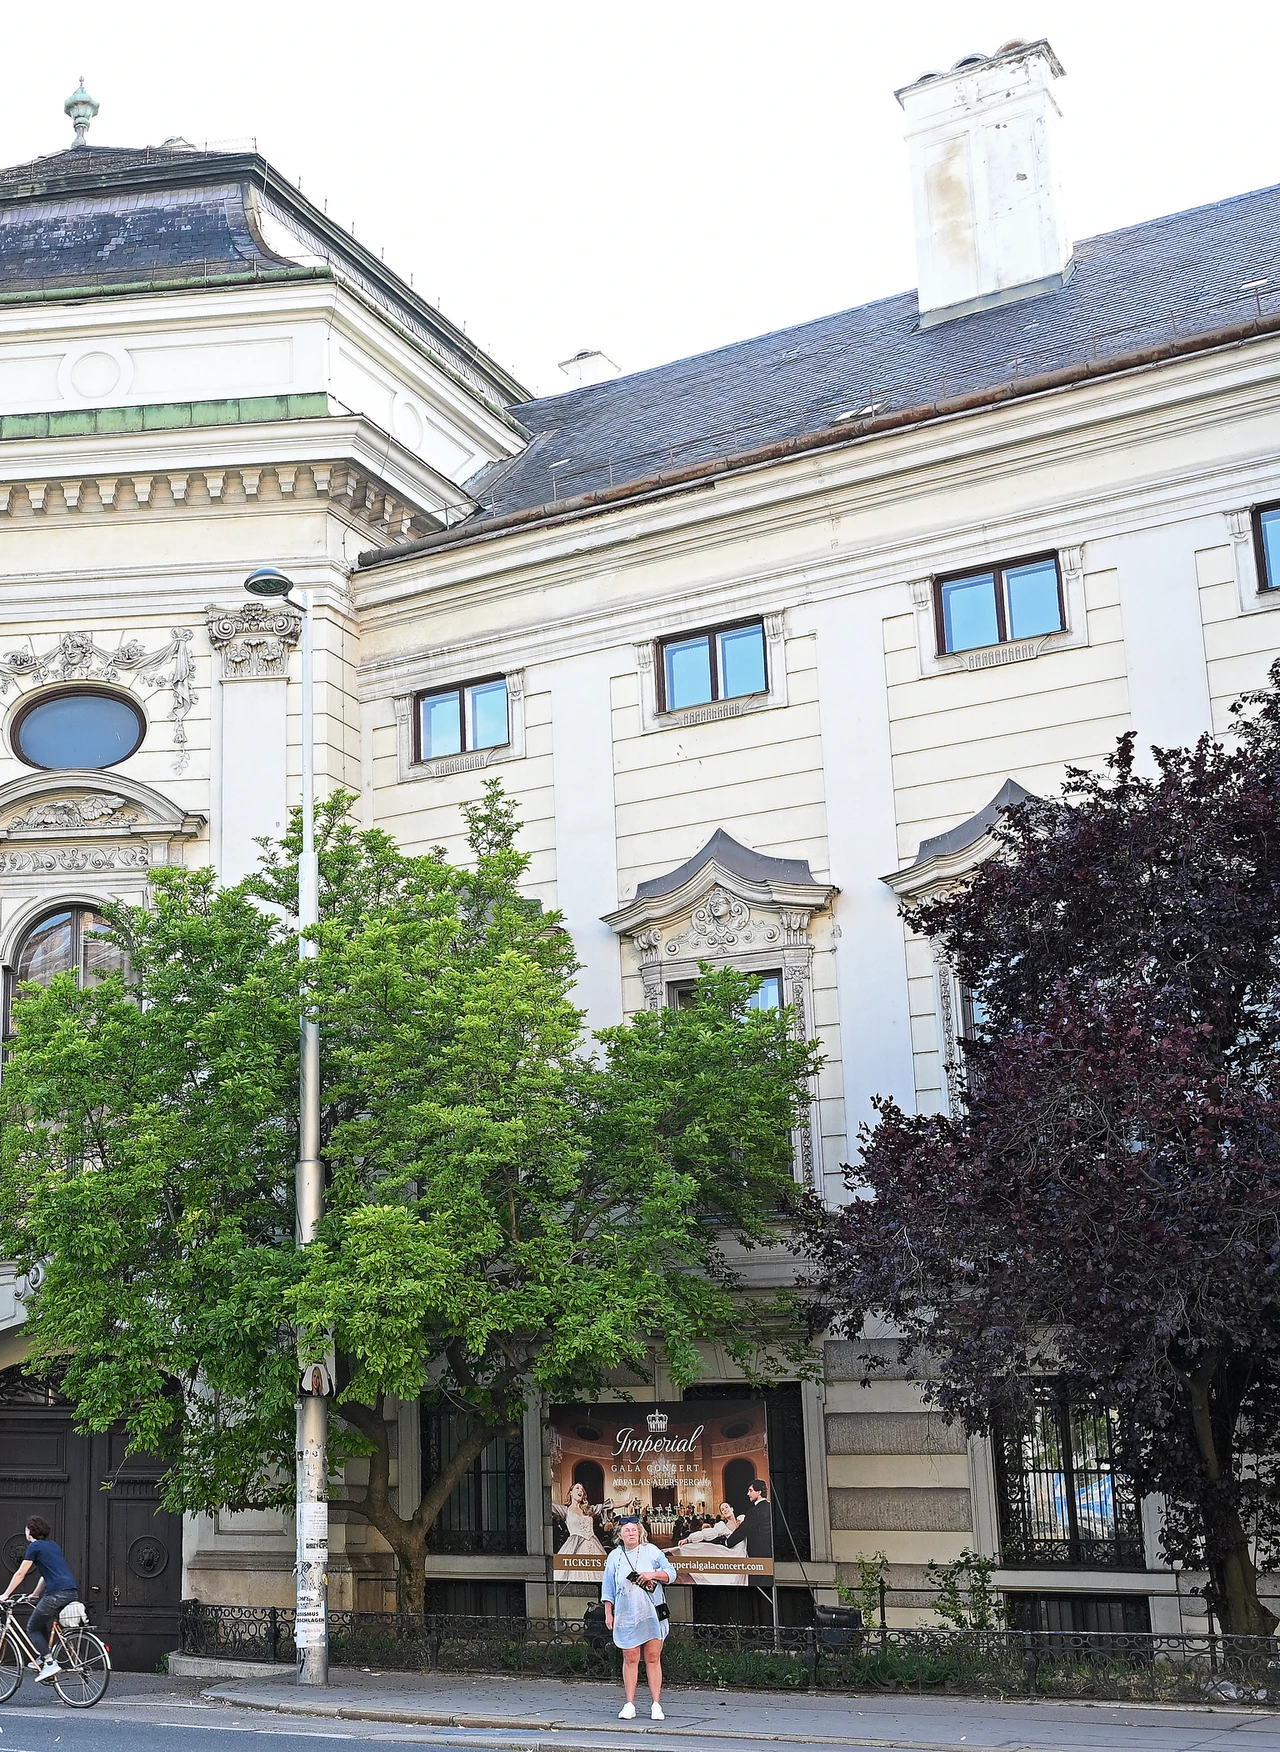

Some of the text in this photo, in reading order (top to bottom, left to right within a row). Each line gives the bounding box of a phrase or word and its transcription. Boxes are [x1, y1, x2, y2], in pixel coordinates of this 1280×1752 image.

[611, 1425, 705, 1465] Imperial
[611, 1464, 700, 1472] GALA CONCERT
[623, 1478, 651, 1486] PALAIS
[652, 1478, 700, 1486] AUERSPERG
[562, 1558, 602, 1567] TICKETS
[671, 1560, 765, 1571] mperialgalaconcert.com
